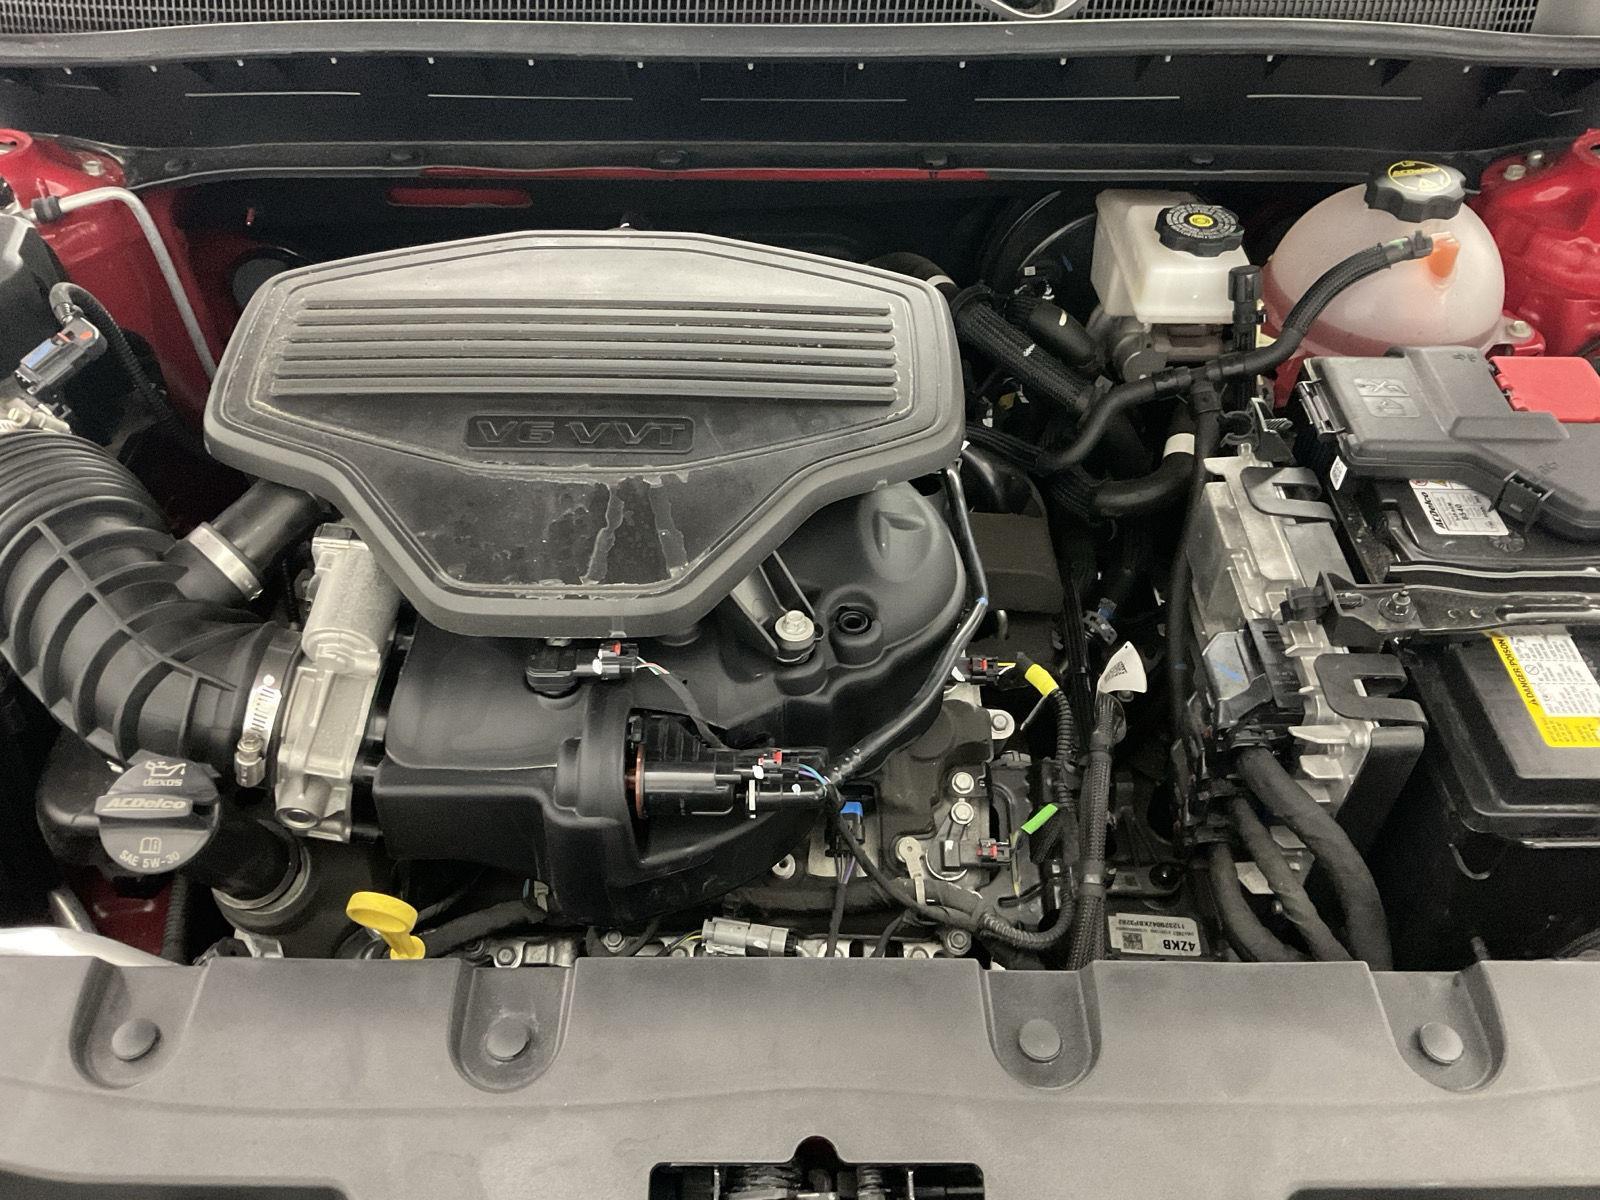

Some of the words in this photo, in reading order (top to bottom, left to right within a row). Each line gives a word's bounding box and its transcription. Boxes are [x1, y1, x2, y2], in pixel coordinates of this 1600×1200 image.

[476, 420, 555, 444] V6
[565, 421, 686, 445] VVT
[1421, 491, 1446, 530] ACDelco
[1497, 638, 1518, 667] POISON
[1512, 667, 1535, 699] DANGER
[142, 778, 184, 787] dexos
[106, 797, 187, 809] ACDelco
[119, 849, 139, 867] SAE
[142, 851, 181, 869] 5W-30
[1163, 939, 1196, 952] 4ZKB
